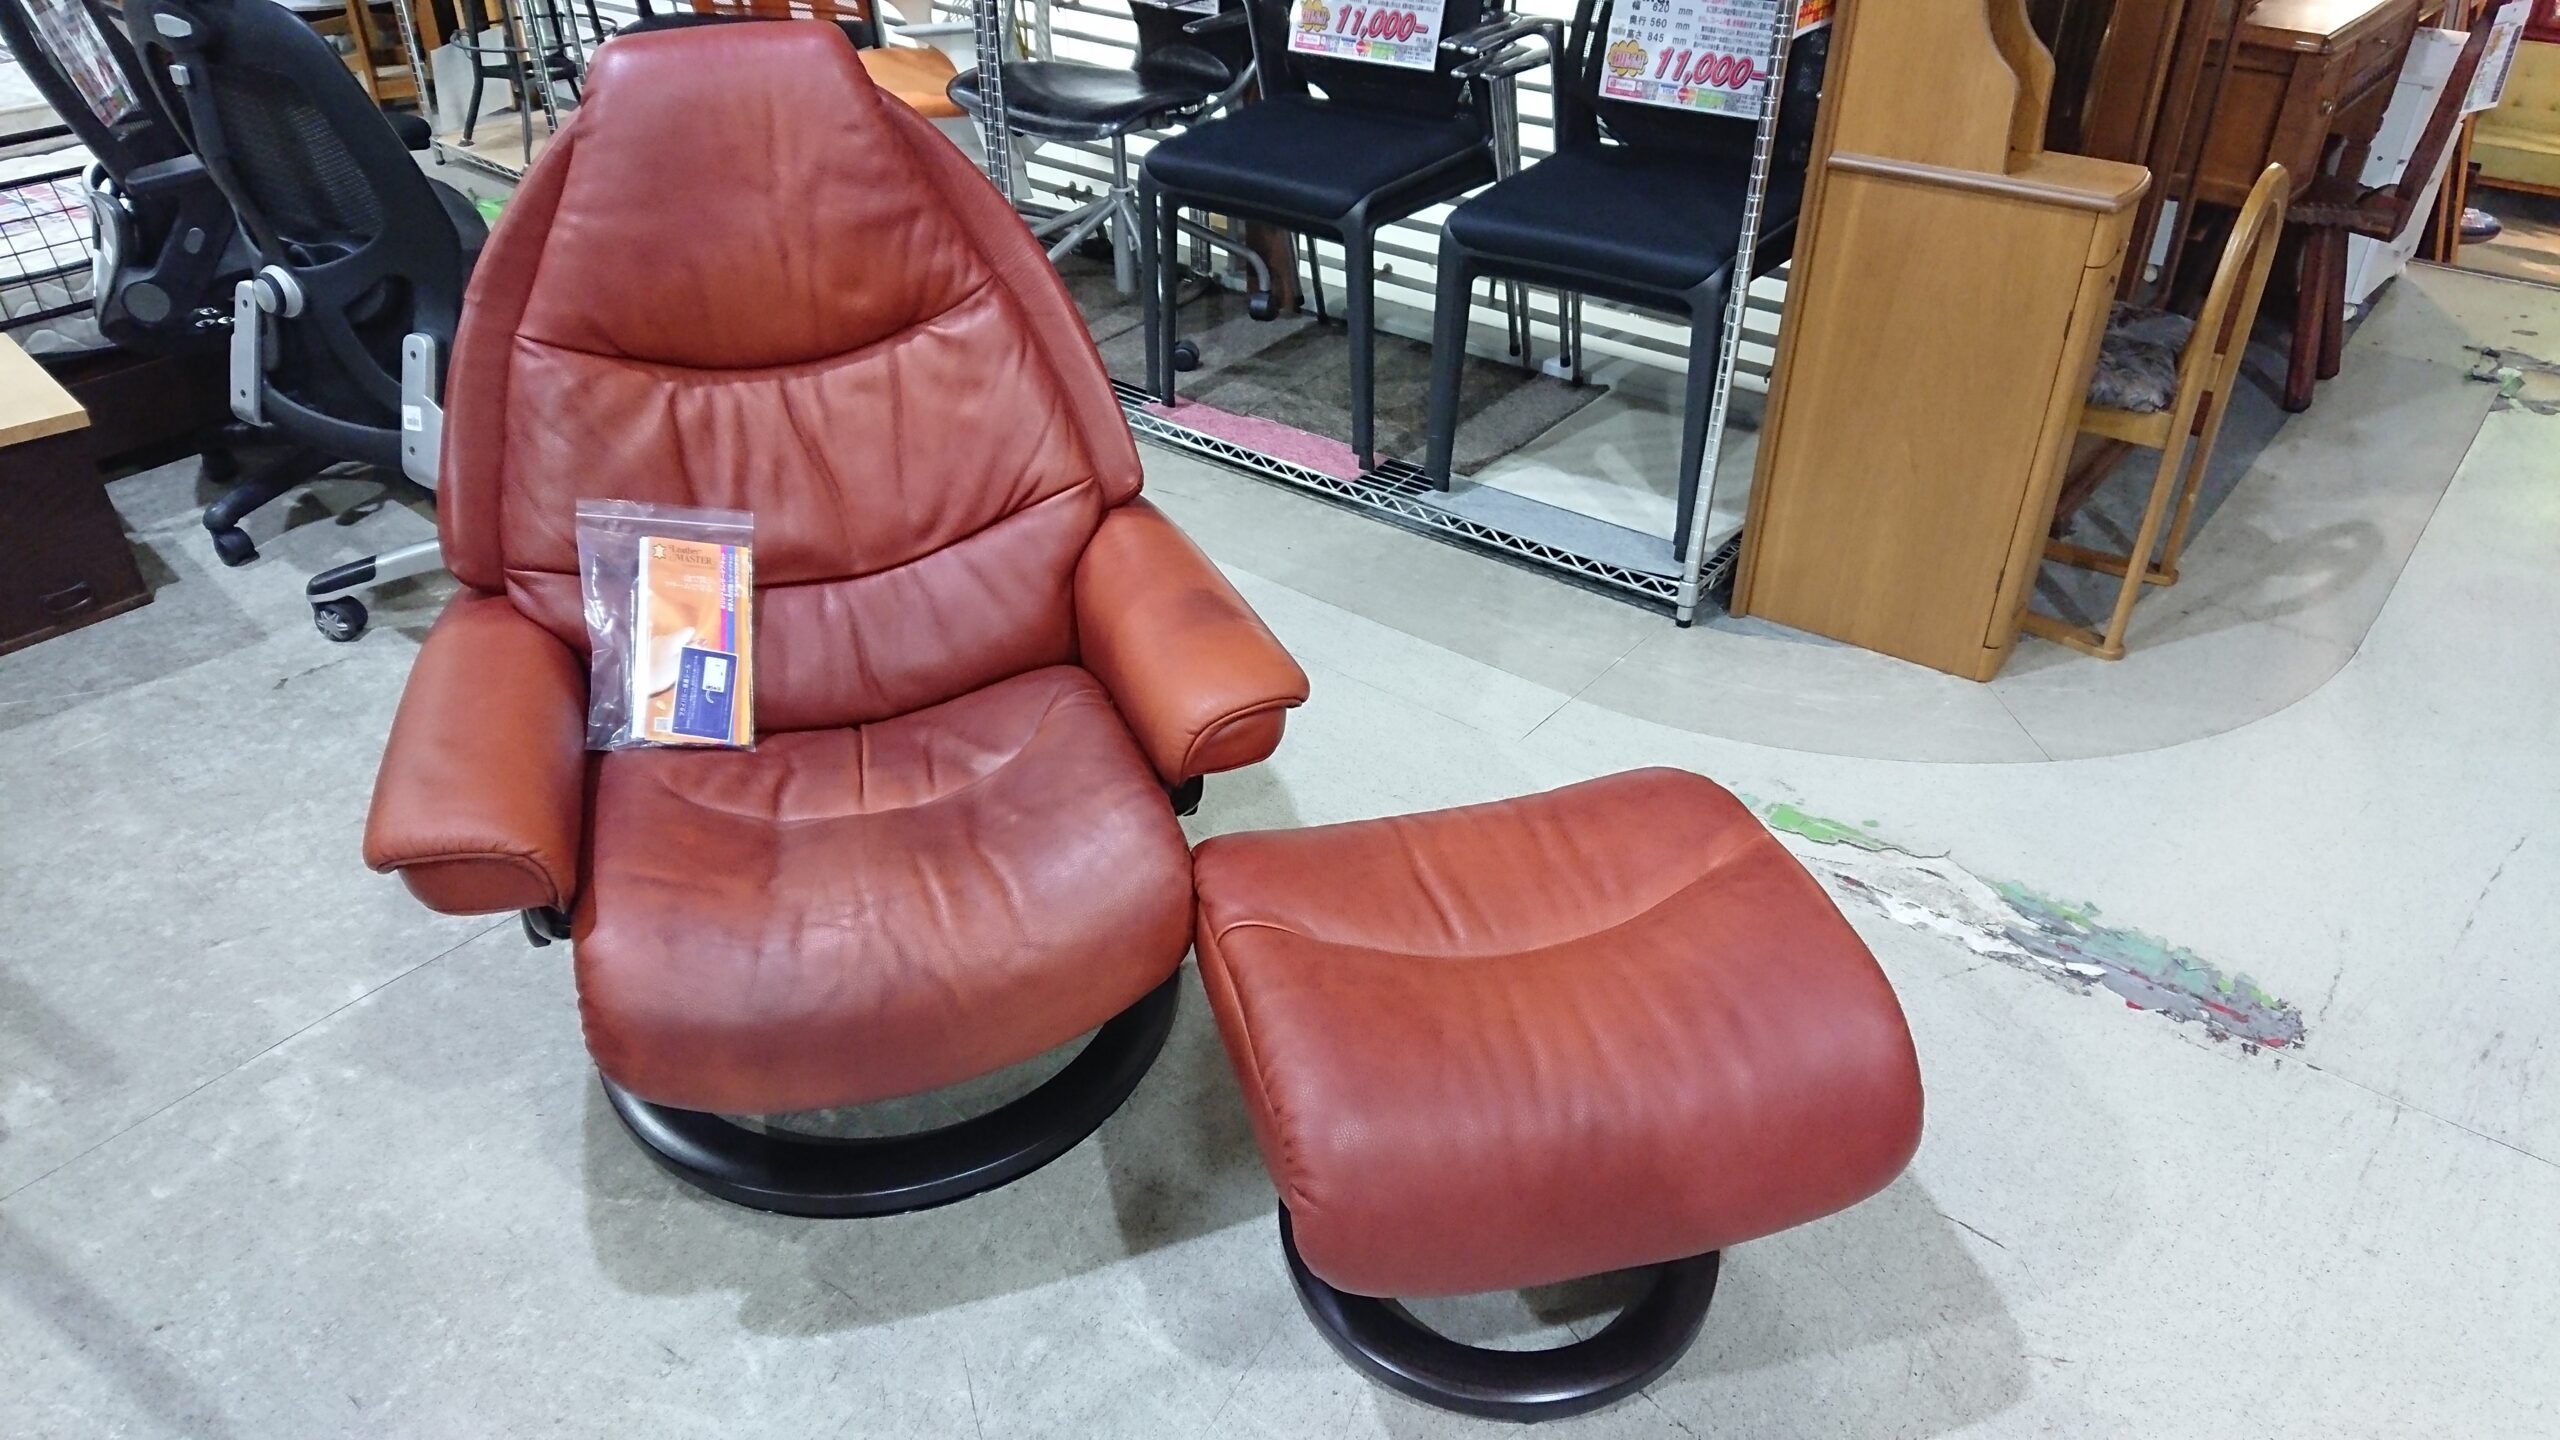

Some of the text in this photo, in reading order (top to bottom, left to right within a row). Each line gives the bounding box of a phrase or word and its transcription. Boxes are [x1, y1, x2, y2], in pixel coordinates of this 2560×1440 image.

[1652, 3, 1670, 13] 620
[1678, 7, 1694, 16] mm
[1629, 15, 1691, 30] 奥行 560 mm
[1626, 28, 1642, 40] 高さ
[1647, 31, 1664, 43] 845
[1672, 36, 1687, 46] mm
[675, 554, 712, 565] MASTER
